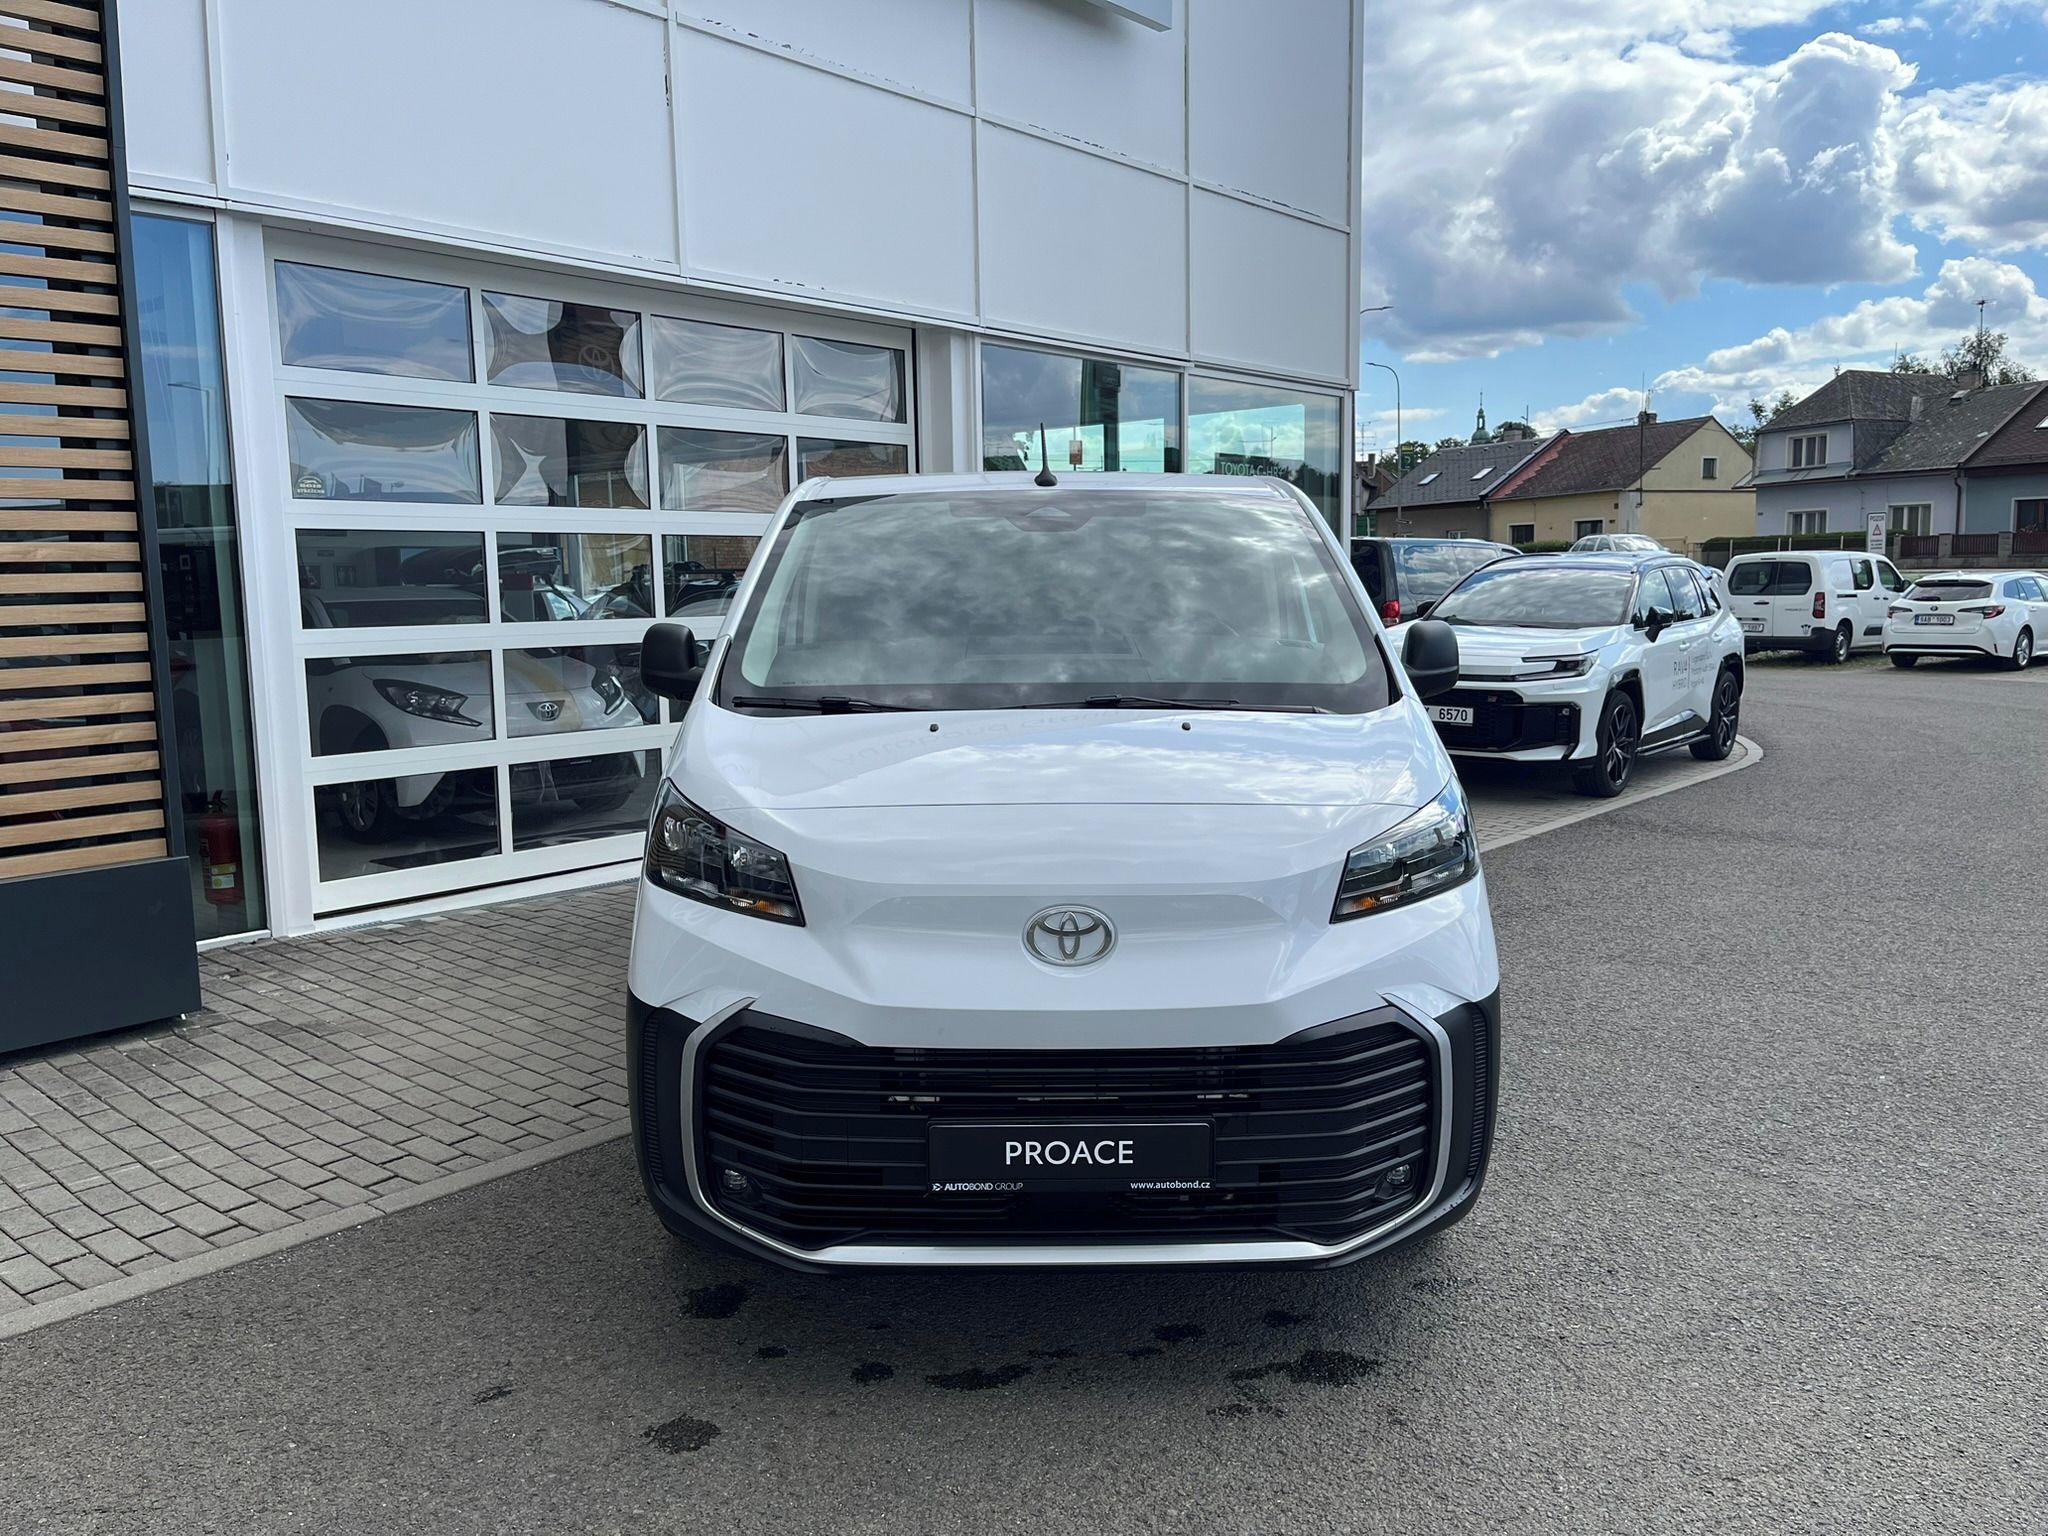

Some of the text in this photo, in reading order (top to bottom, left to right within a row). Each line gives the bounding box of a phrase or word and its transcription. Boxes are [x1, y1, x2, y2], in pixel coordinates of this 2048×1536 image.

[1220, 462, 1255, 476] TOYOTA
[1439, 708, 1467, 721] 6570
[1005, 1140, 1134, 1165] PROACE
[944, 1182, 1023, 1191] AUTOBOND GROUP
[1130, 1180, 1211, 1189] www.autobond.cz
